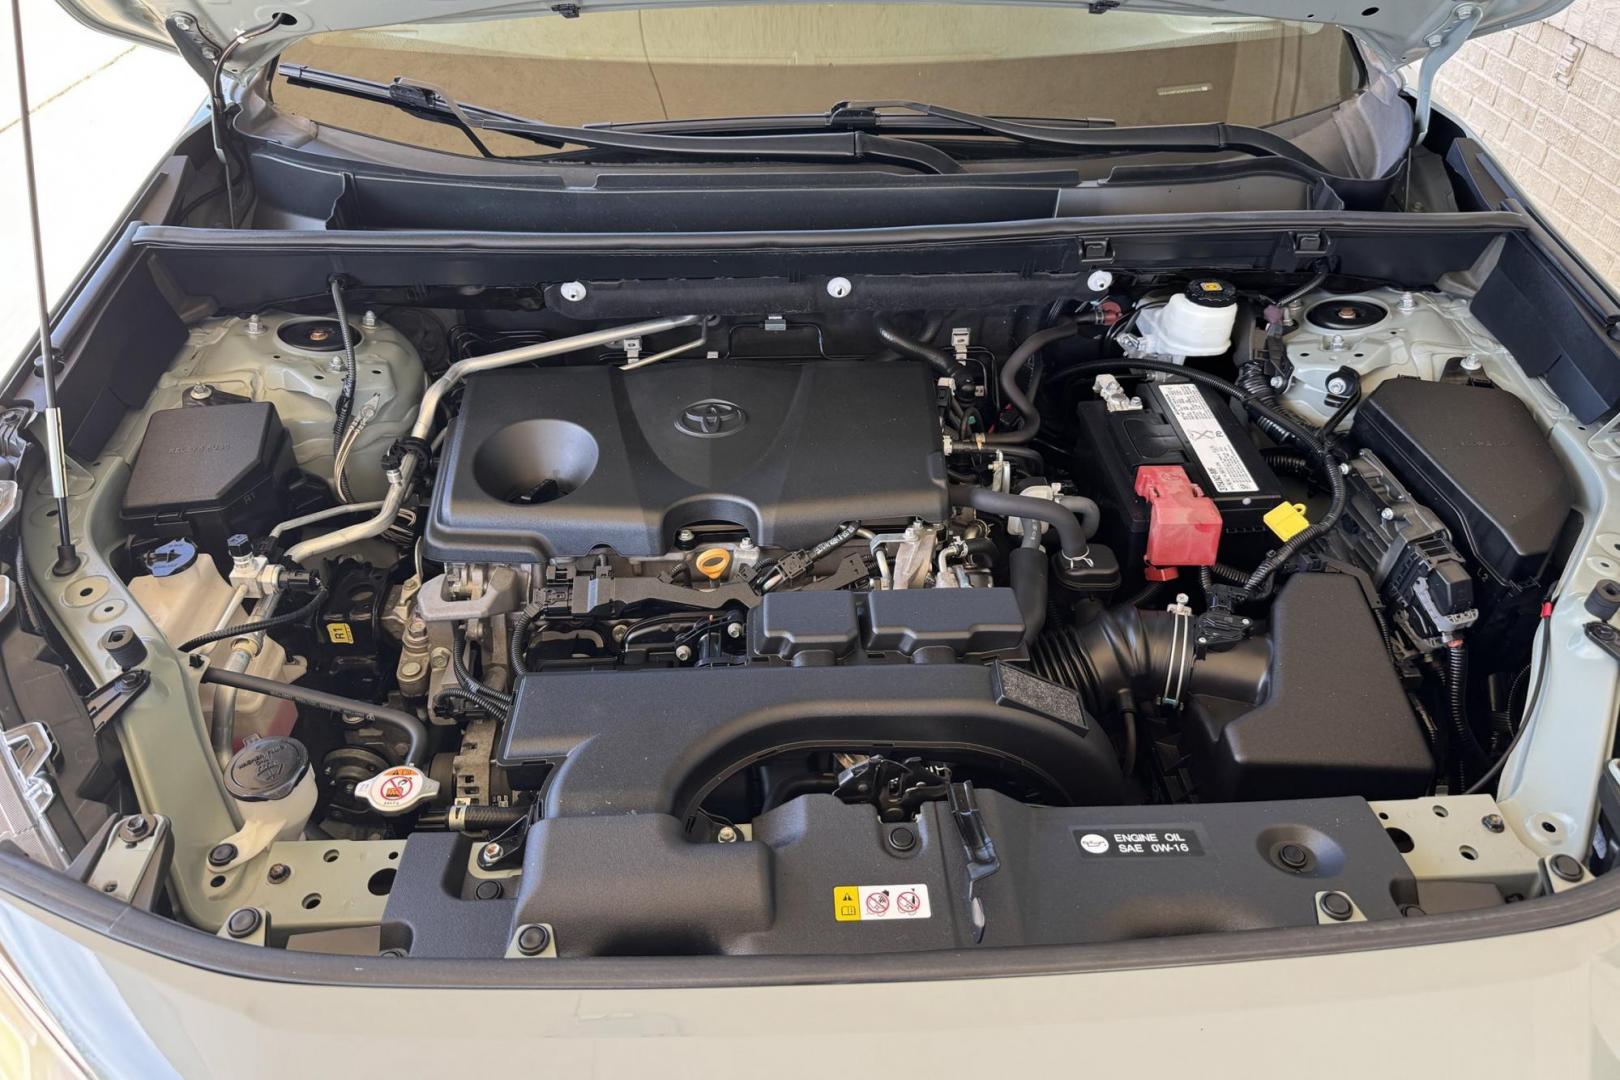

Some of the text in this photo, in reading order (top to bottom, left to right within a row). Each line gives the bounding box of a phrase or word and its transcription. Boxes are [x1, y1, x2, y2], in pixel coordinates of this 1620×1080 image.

[332, 627, 346, 640] R1
[1113, 833, 1186, 843] ENGINE OIL
[1118, 844, 1189, 853] SAE 0W-16
